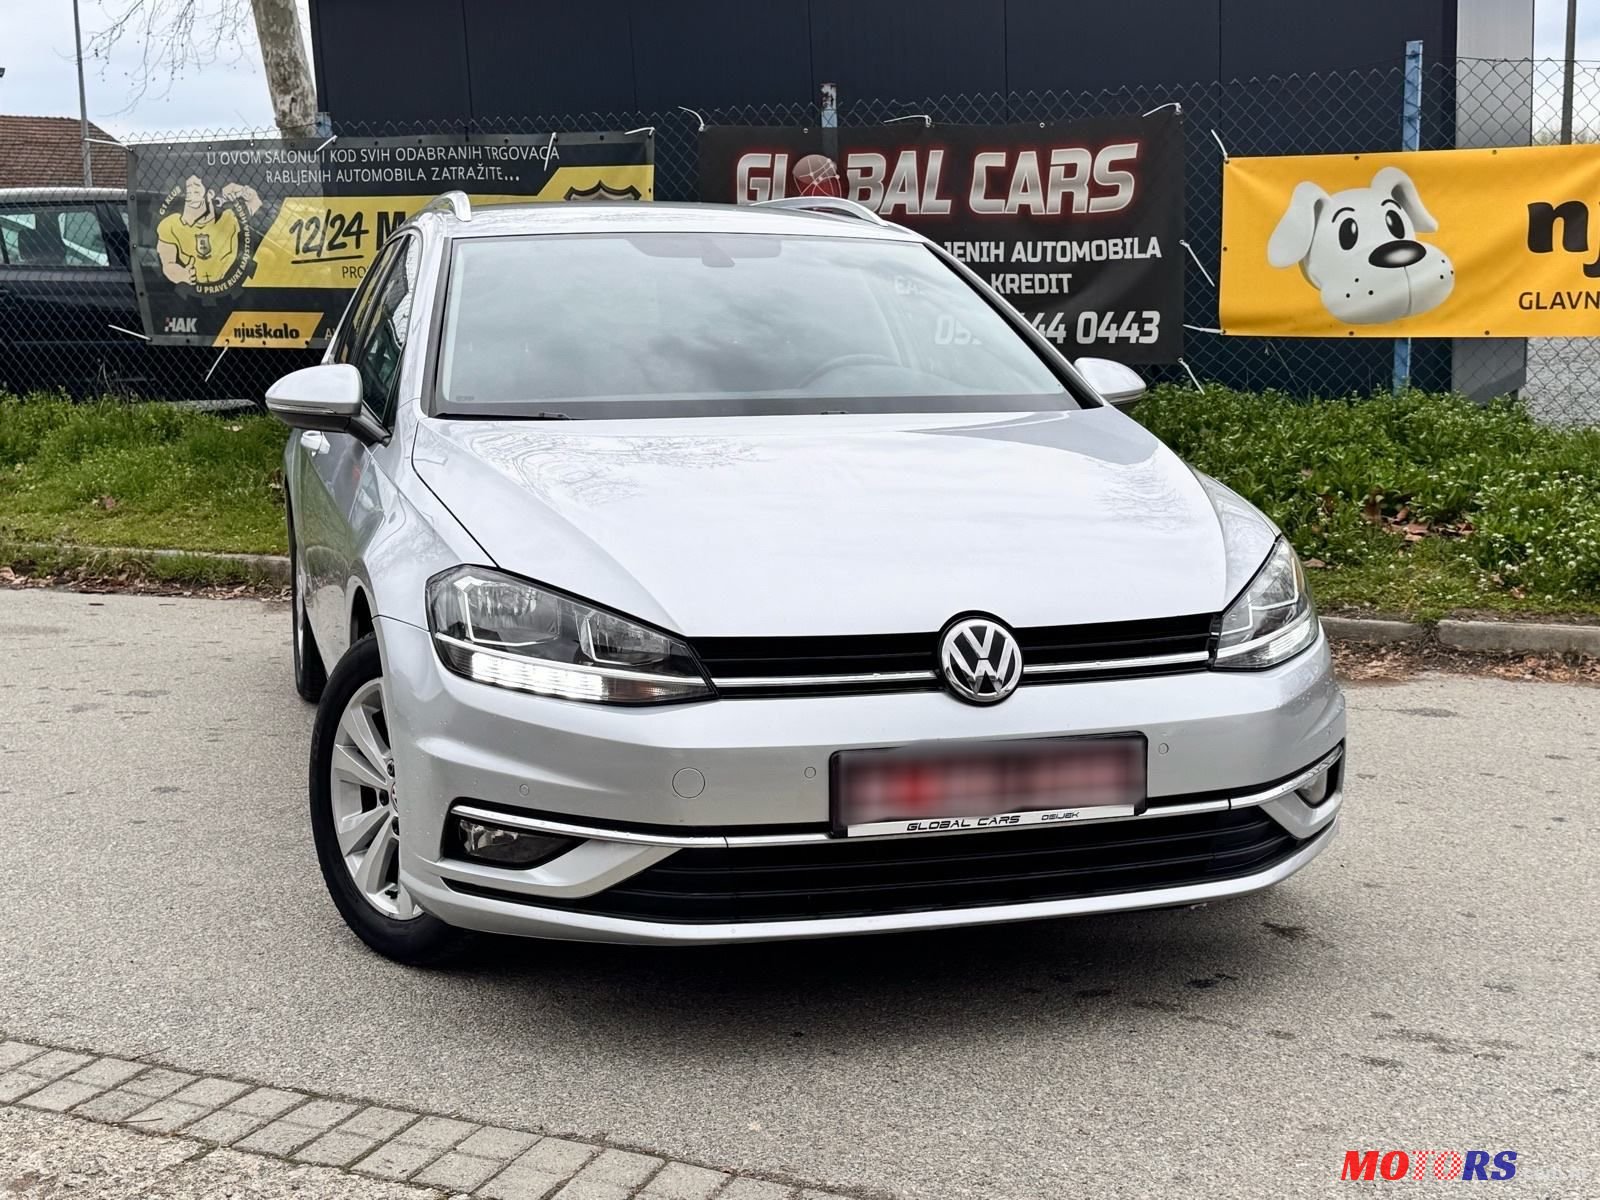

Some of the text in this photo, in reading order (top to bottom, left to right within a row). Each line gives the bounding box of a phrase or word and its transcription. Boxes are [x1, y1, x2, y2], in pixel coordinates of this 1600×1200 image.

[207, 152, 216, 165] U
[220, 151, 262, 165] OVOM
[265, 150, 317, 164] SALONU
[330, 150, 357, 163] KOD
[361, 149, 390, 162] SVIH
[395, 147, 482, 161] ODABRANIH
[484, 146, 560, 160] TRGOVACA
[266, 163, 520, 185] RABLJENIH AUTOMOBILA ZATRAŽITE...
[970, 143, 1138, 215] CARS
[289, 209, 369, 257] 12/24
[1010, 236, 1162, 263] AUTOMOBILA
[990, 273, 1073, 294] KREDIT
[233, 323, 300, 343] njuškalo
[1076, 310, 1161, 344] 0443
[906, 818, 971, 832] GLOBAL
[977, 815, 1021, 827] CARS
